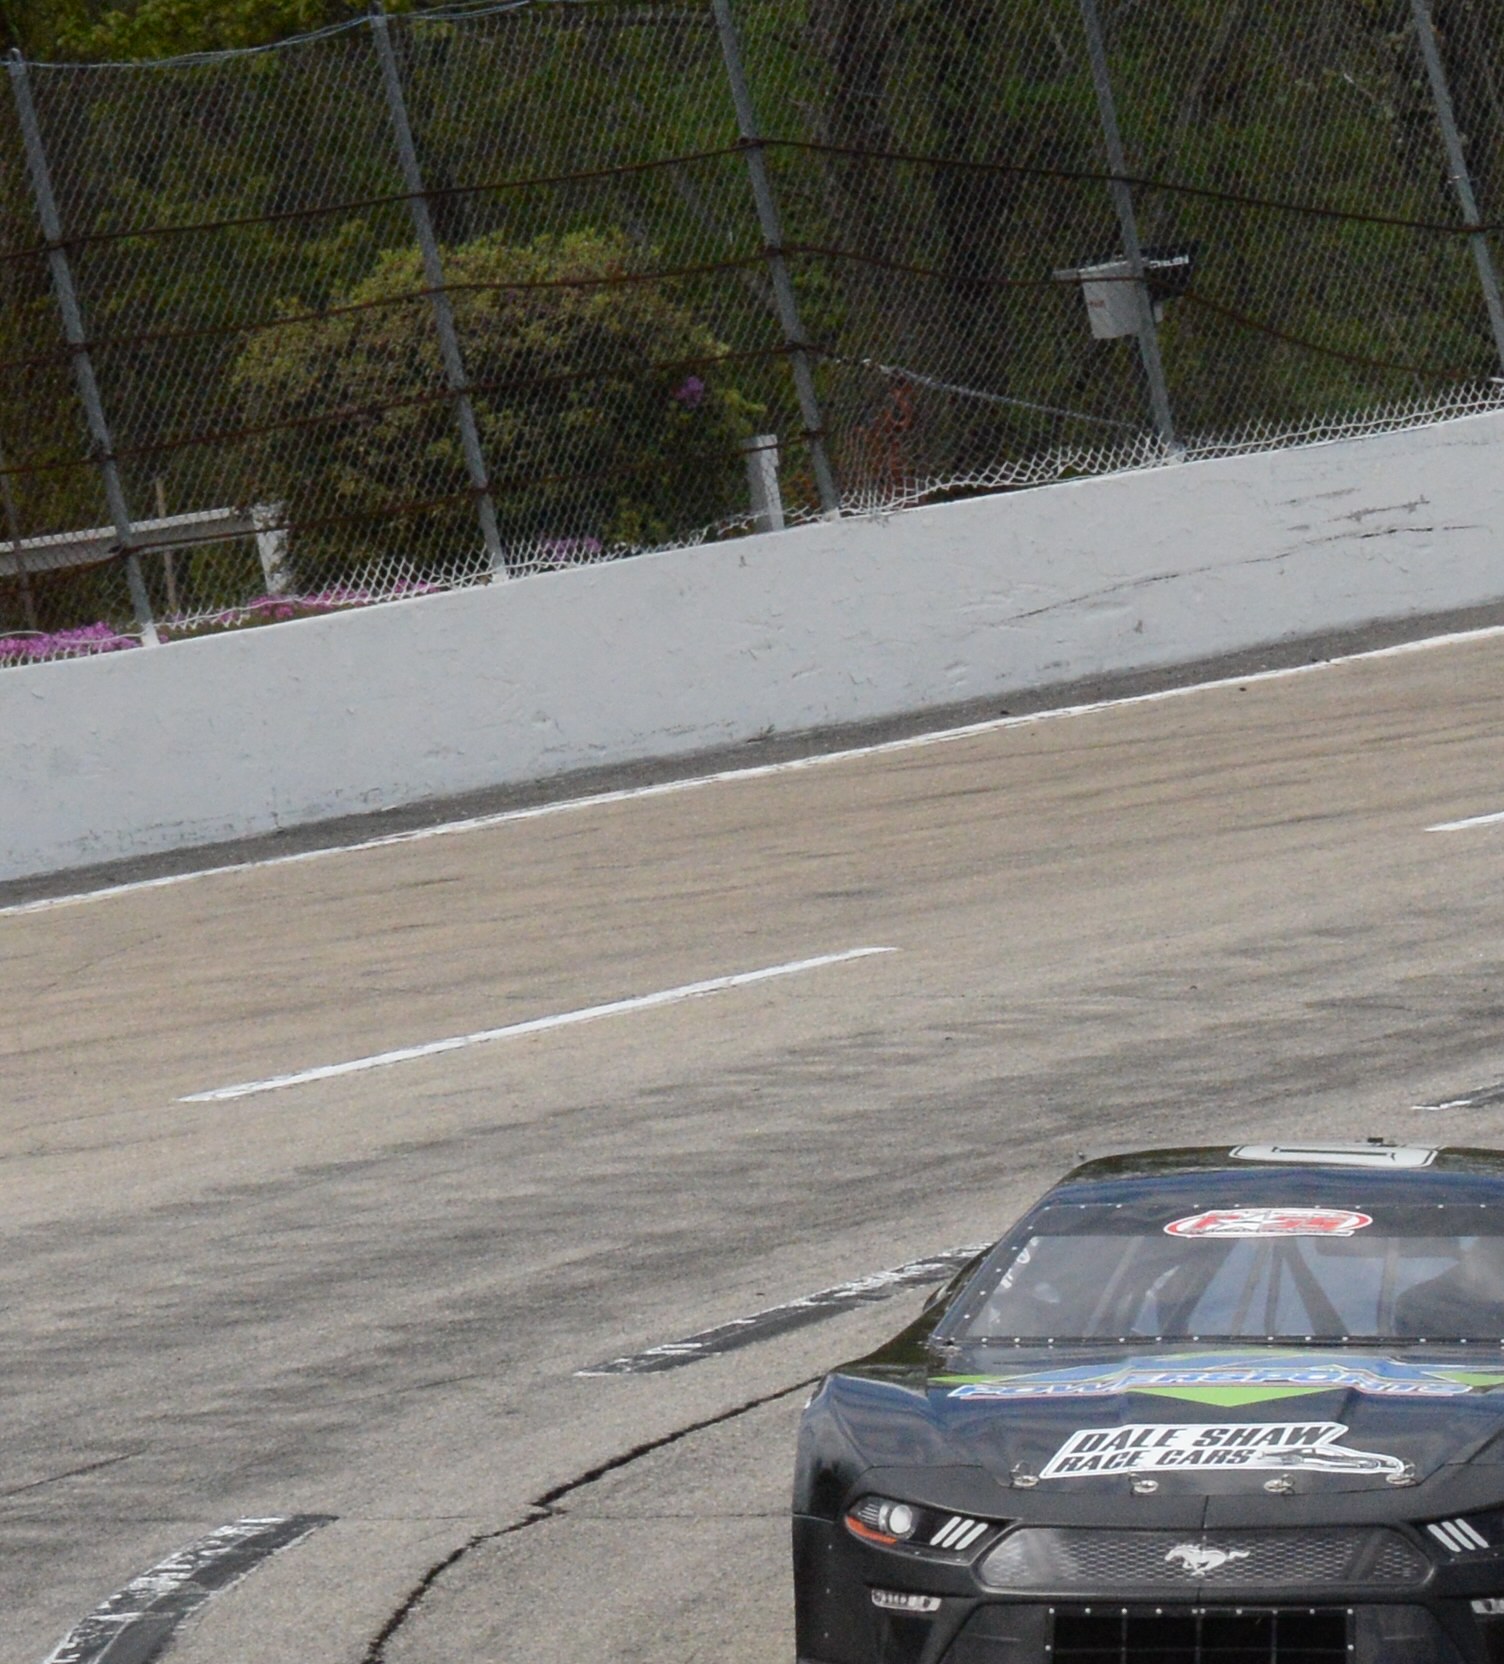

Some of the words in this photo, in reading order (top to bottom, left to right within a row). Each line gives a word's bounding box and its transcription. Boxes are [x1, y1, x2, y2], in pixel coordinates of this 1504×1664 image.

[1071, 1428, 1187, 1453] DALE
[1192, 1426, 1338, 1447] SHAW
[1054, 1450, 1151, 1473] RACE
[1155, 1449, 1257, 1466] CARS
